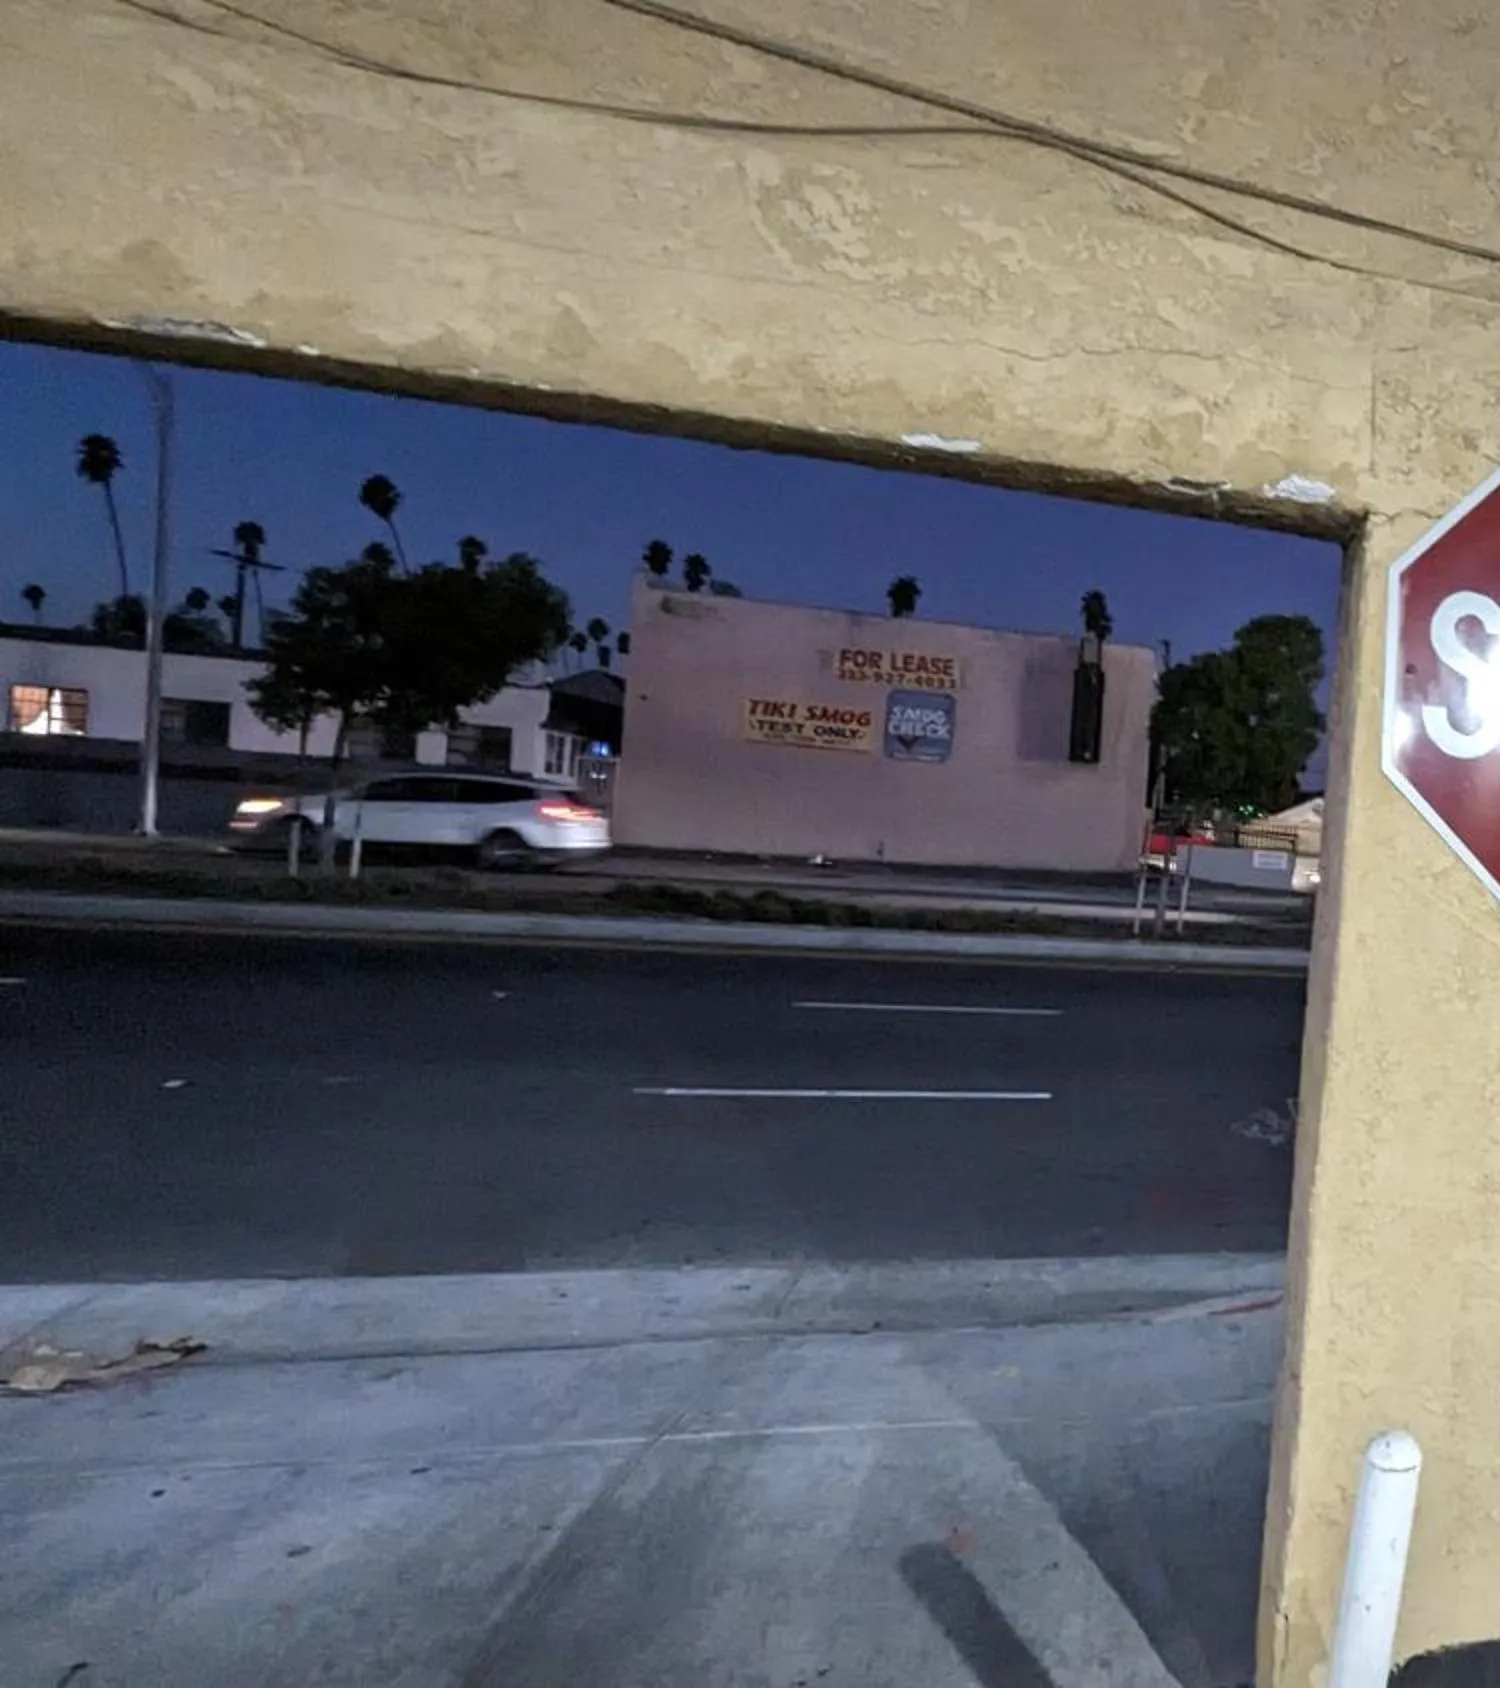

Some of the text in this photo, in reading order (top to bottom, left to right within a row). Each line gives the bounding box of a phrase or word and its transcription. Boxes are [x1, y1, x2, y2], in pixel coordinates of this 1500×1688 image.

[840, 648, 954, 677] FOR LEASE
[748, 699, 871, 727] TIKI SMOG
[892, 704, 947, 724] SMOG
[757, 719, 806, 734] TEST
[813, 725, 861, 740] ONLY
[888, 719, 951, 739] CHECK
